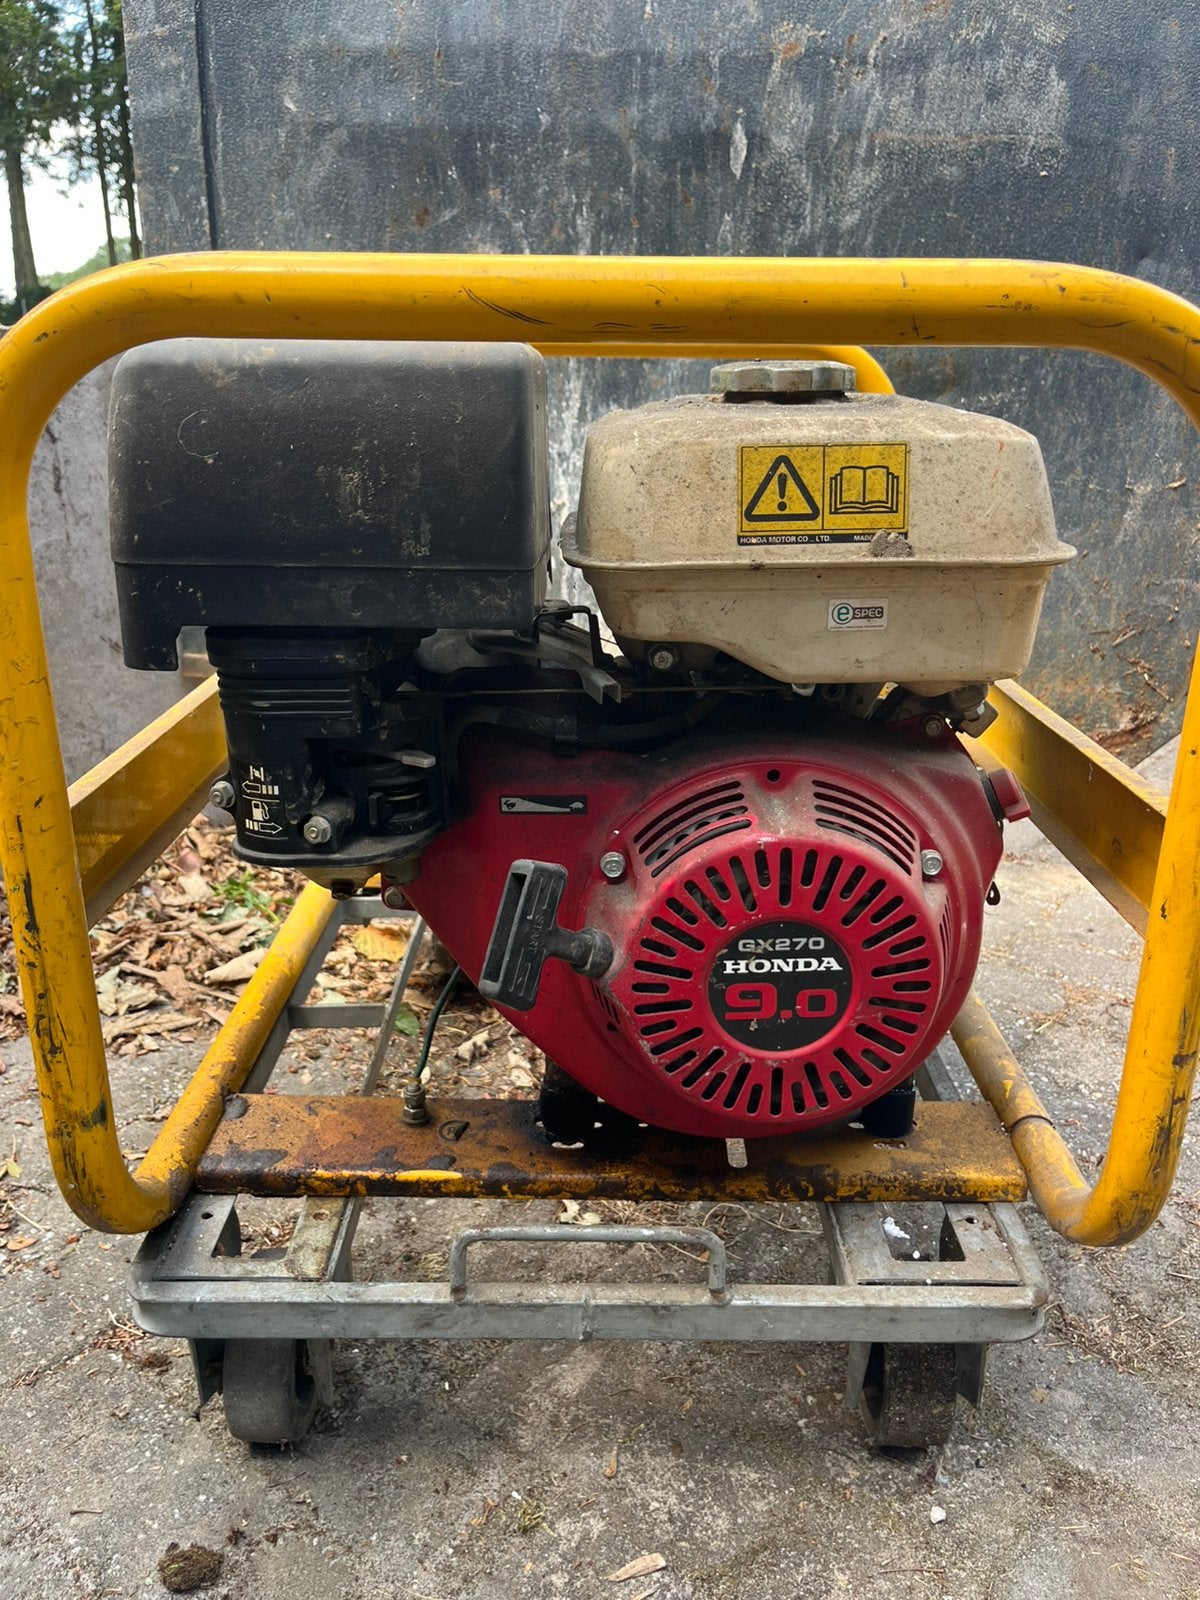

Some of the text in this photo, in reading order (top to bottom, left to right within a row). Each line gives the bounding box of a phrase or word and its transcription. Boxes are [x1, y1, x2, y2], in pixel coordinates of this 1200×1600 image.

[854, 608, 882, 618] SPEC
[738, 937, 825, 952] GX270
[723, 957, 843, 974] HONDA
[725, 982, 838, 1021] 9.0
